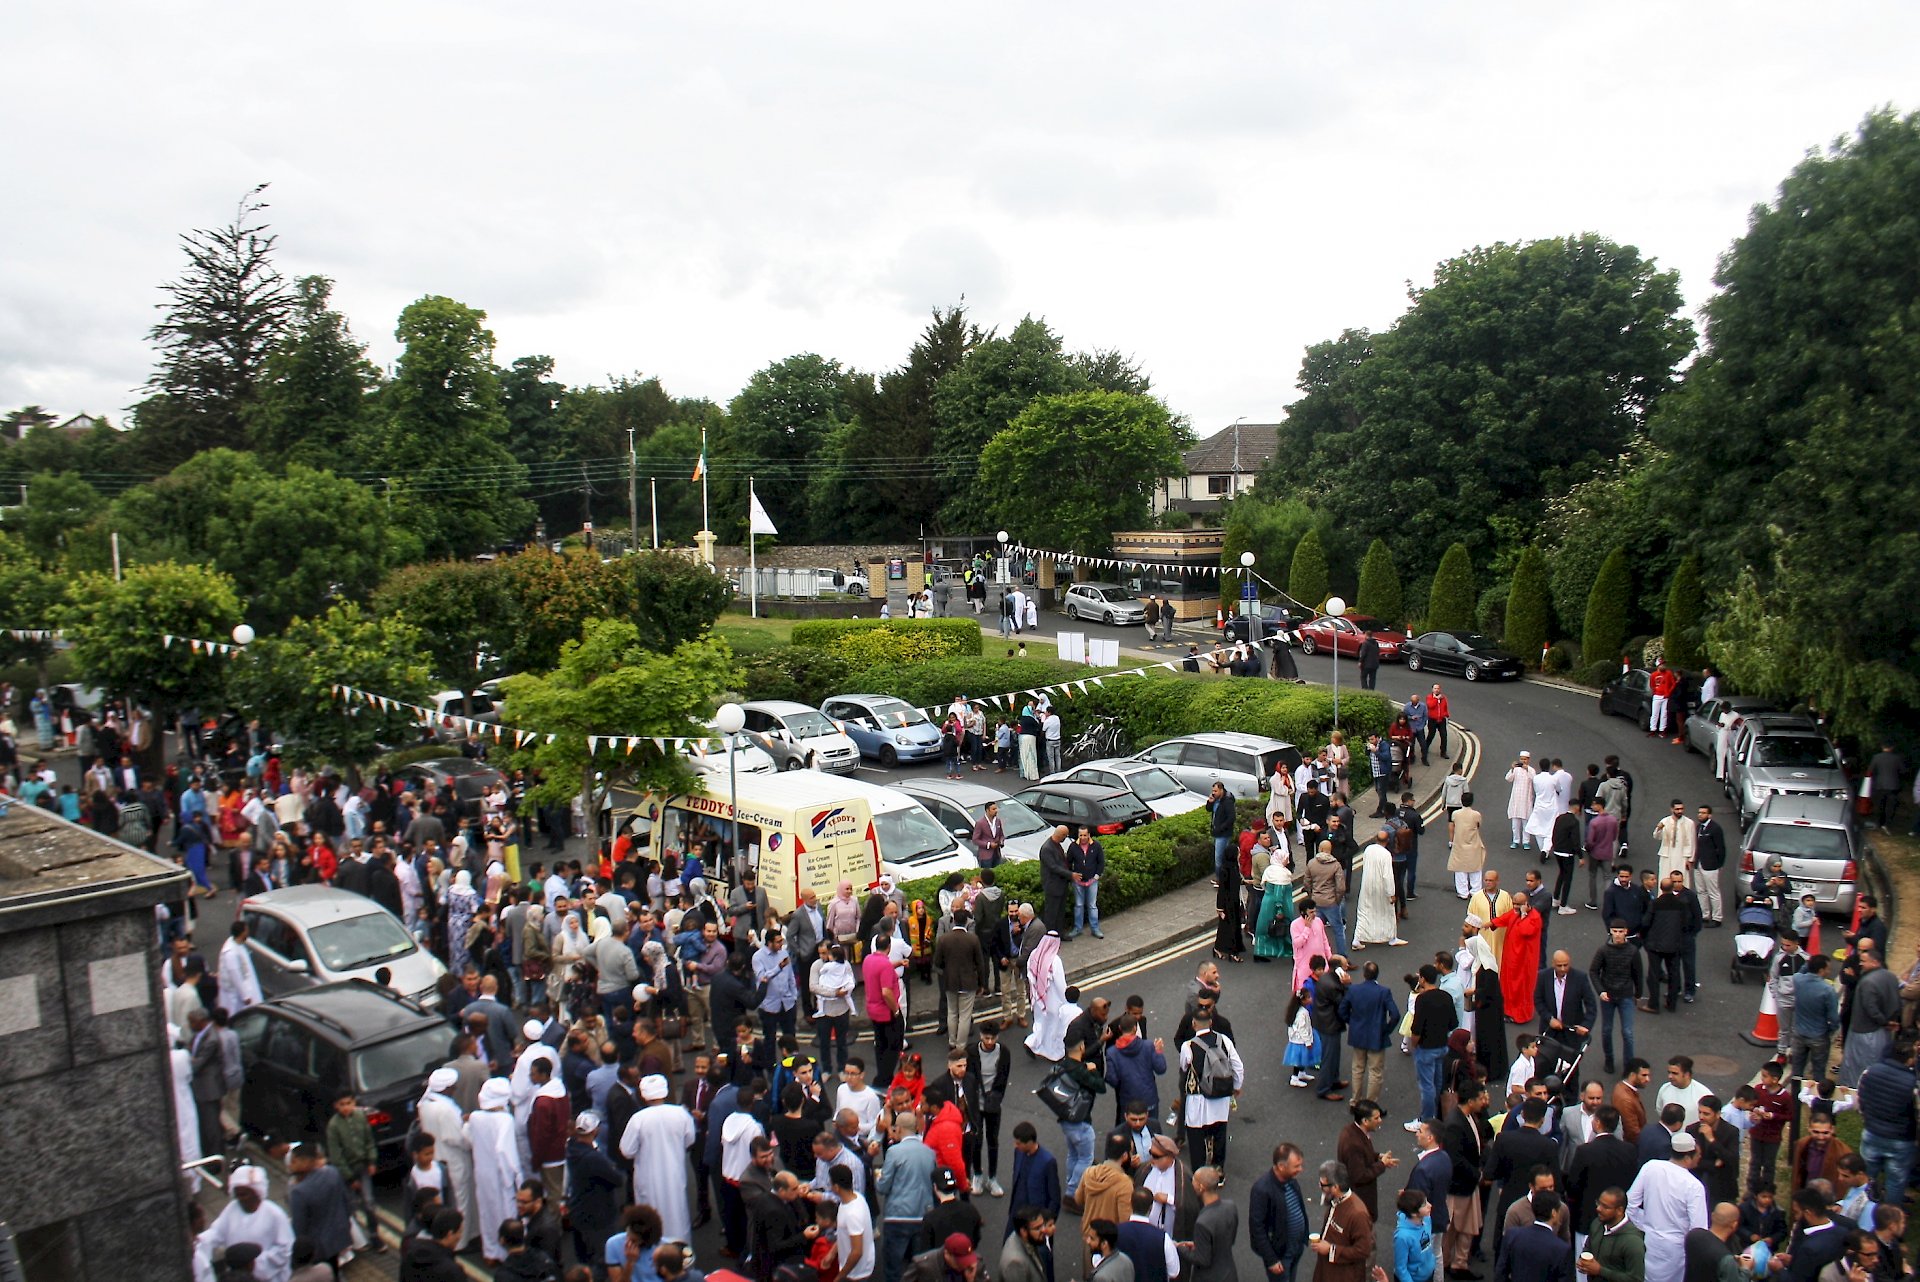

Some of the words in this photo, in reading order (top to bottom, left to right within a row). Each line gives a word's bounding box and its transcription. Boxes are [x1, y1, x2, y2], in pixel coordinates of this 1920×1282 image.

[686, 795, 734, 817] TEDDY'S
[737, 809, 783, 828] Ice-Cream
[823, 828, 857, 839] Ice-Cream
